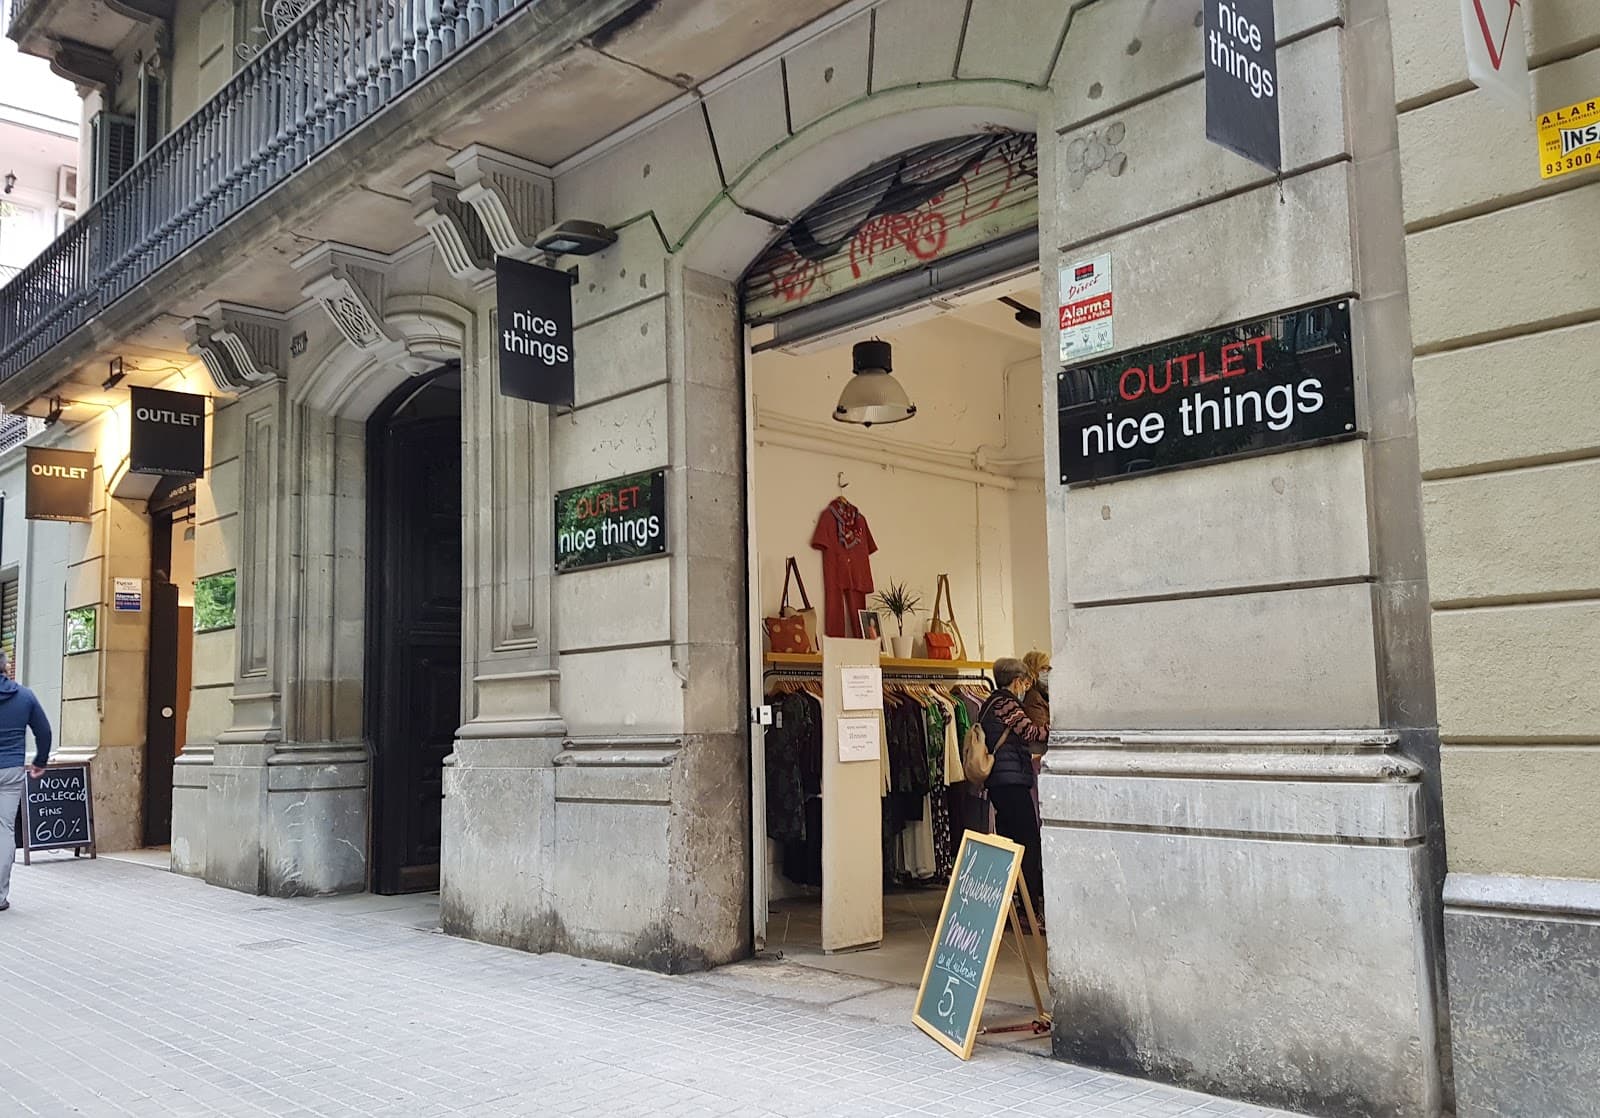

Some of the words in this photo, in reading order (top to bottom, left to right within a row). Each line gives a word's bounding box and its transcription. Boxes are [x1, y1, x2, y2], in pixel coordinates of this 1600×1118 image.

[1218, 2, 1262, 52] nice
[1209, 29, 1274, 99] things
[513, 309, 558, 337] nice
[1061, 299, 1110, 322] Alarma
[503, 330, 569, 366] things
[1118, 335, 1272, 401] OUTLET
[136, 407, 200, 426] OUTLET
[1082, 412, 1165, 456] nice
[1178, 378, 1324, 437] things
[31, 464, 88, 480] OUTLET
[576, 486, 640, 520] OUTLET
[560, 526, 596, 554] nice
[601, 516, 660, 547] things
[40, 777, 80, 790] NOVA
[35, 818, 80, 842] 60%
